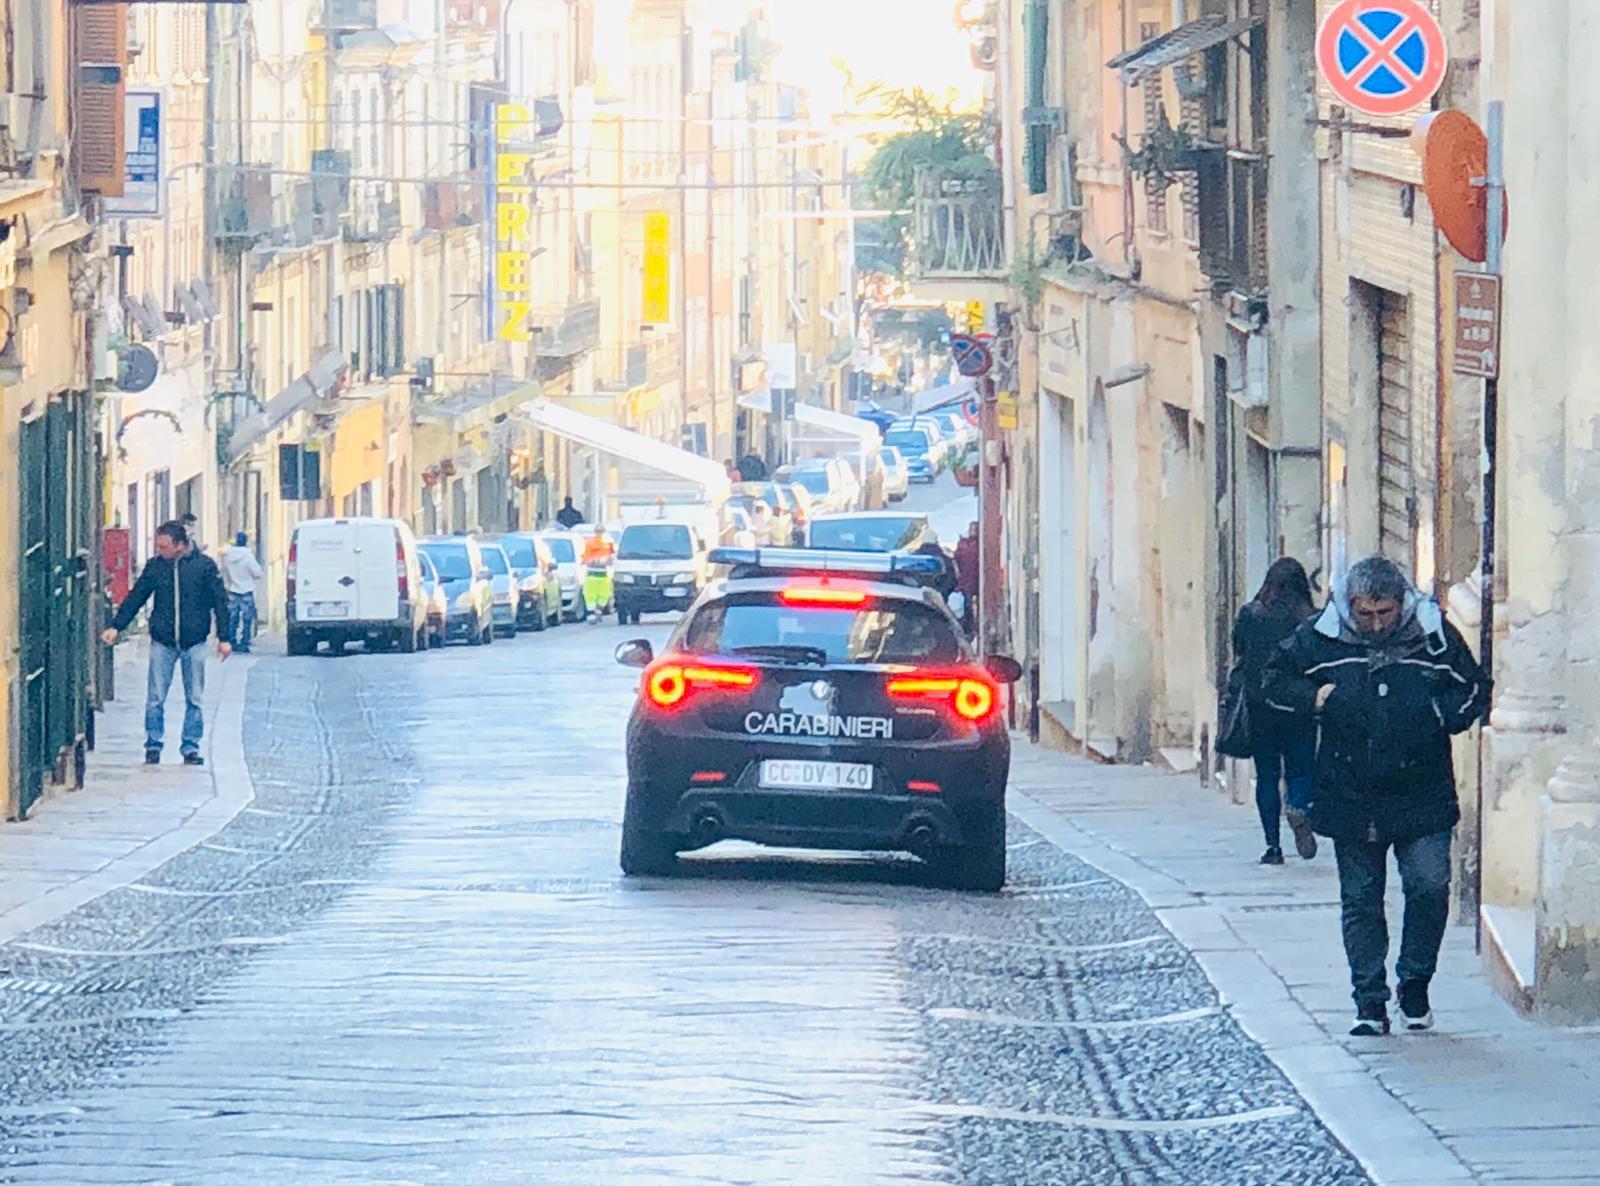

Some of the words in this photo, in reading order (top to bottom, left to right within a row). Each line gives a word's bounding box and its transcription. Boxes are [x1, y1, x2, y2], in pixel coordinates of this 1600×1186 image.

[496, 103, 533, 341] PEREZ
[744, 711, 893, 739] CARABINIERI
[835, 766, 869, 787] 140
